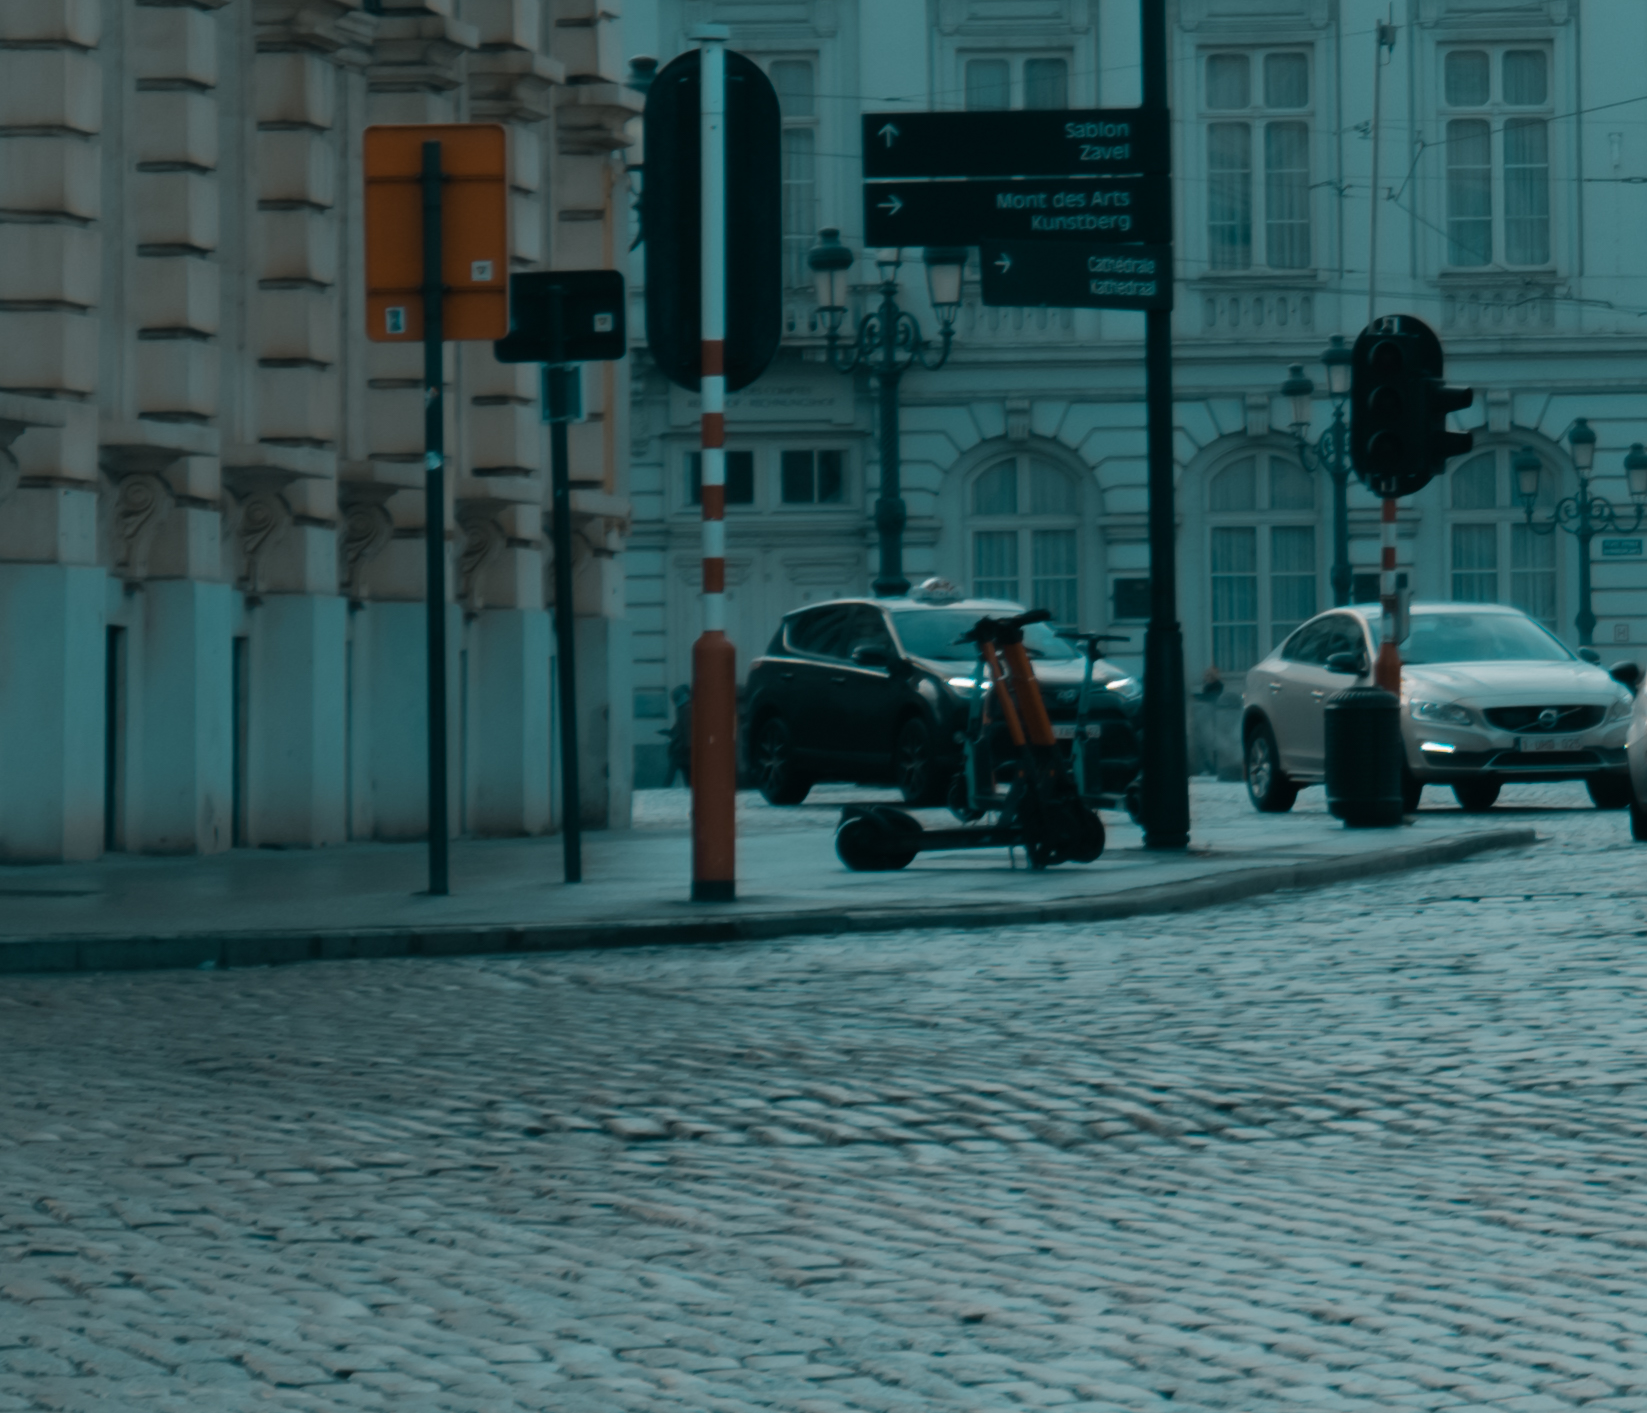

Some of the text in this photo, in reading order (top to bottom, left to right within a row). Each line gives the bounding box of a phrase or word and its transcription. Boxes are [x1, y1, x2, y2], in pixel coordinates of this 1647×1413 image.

[1065, 122, 1129, 138] Sablon
[1079, 143, 1130, 160] Zavel
[997, 191, 1130, 209] Mont des Arts
[1031, 214, 1131, 231] Kunstberg
